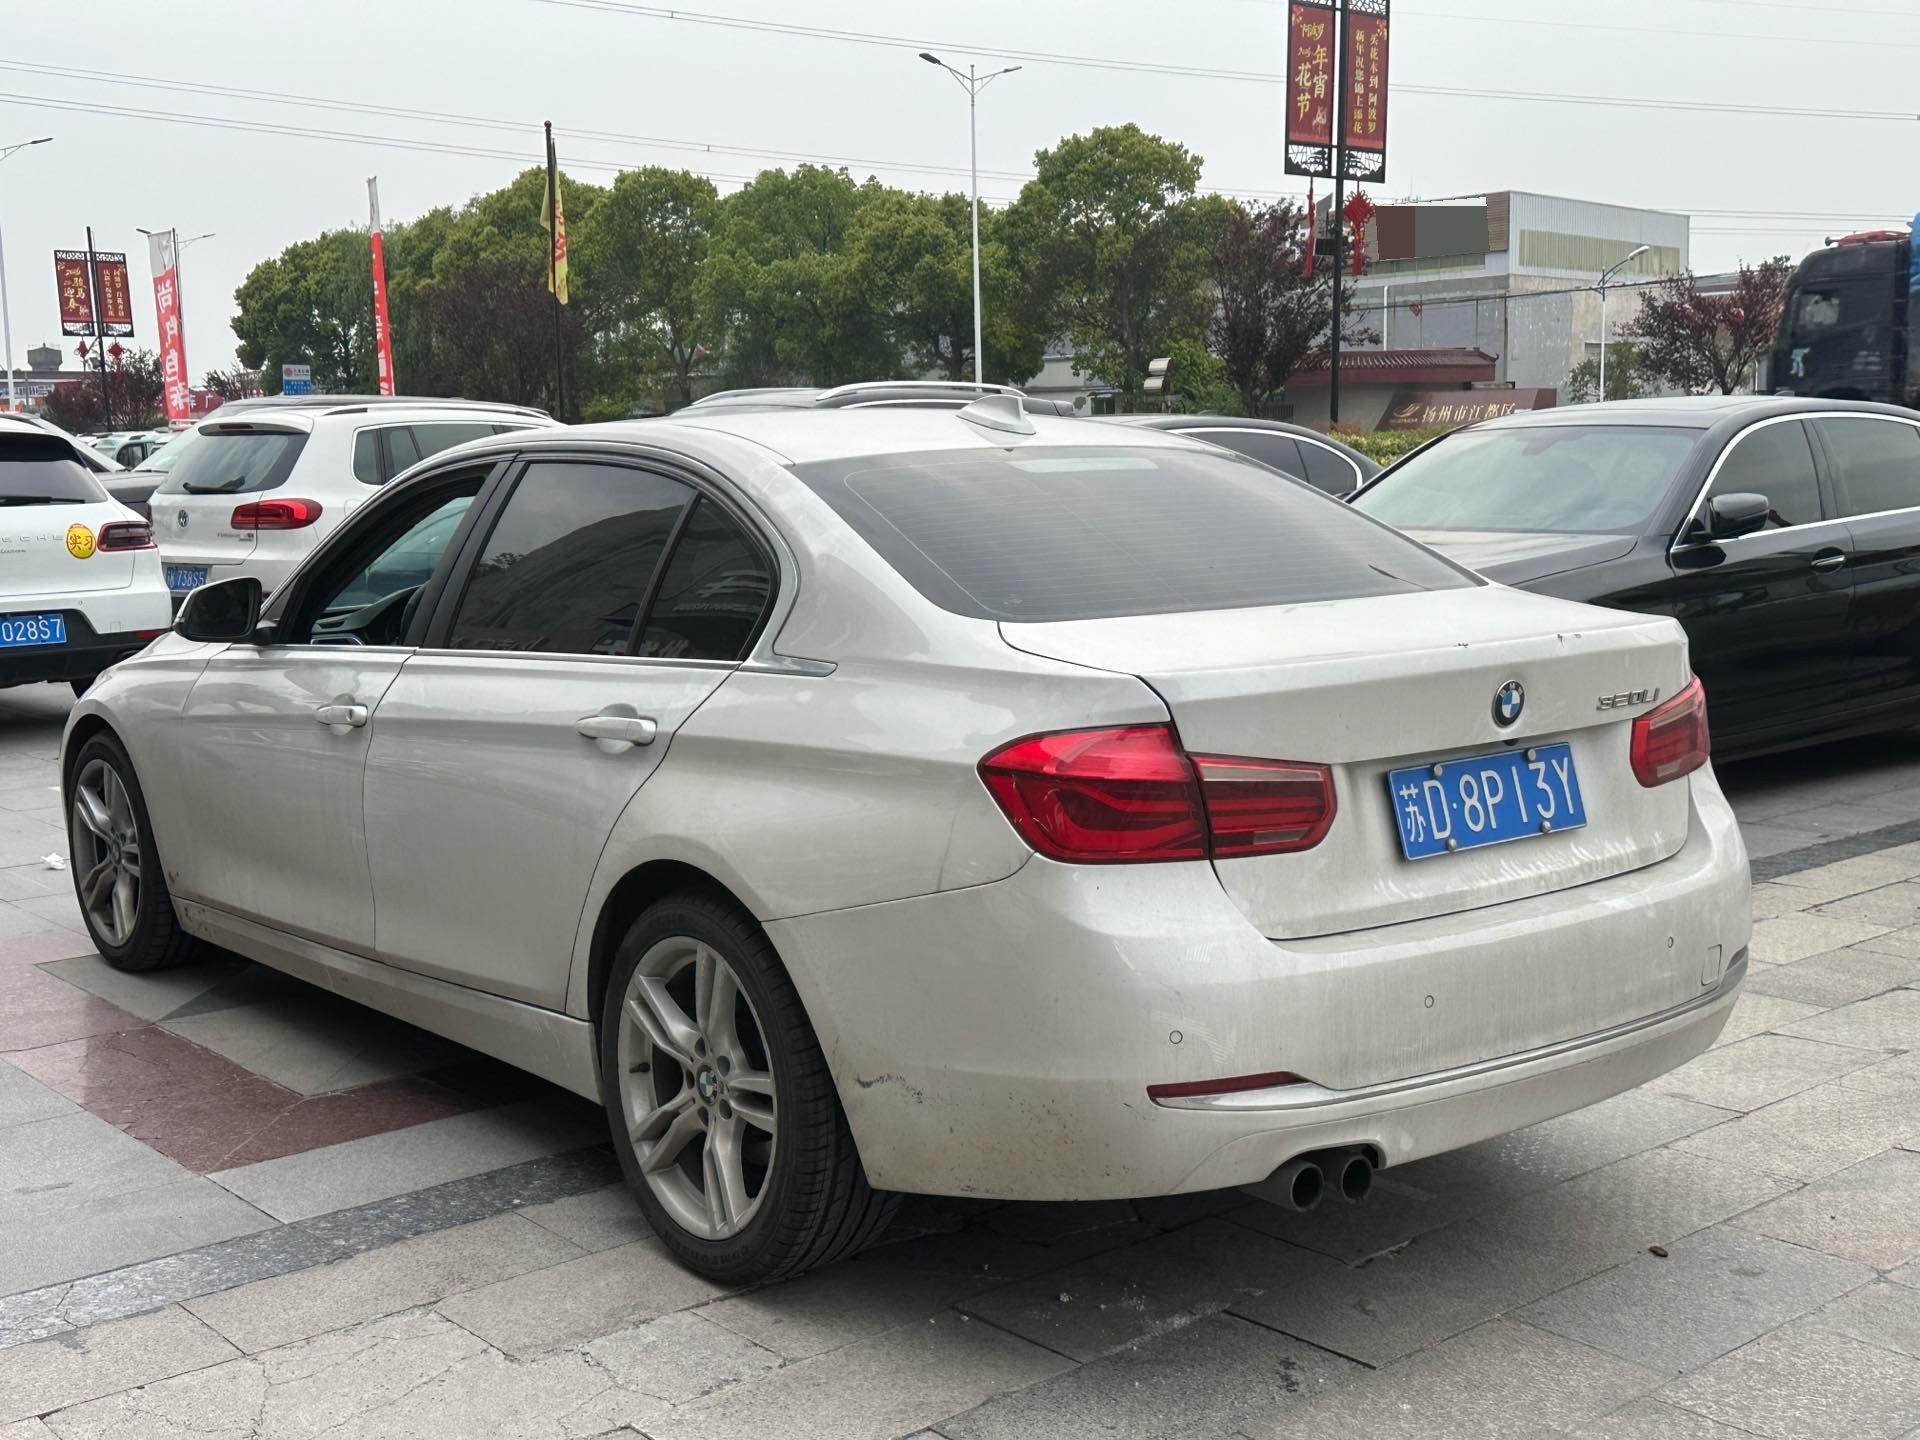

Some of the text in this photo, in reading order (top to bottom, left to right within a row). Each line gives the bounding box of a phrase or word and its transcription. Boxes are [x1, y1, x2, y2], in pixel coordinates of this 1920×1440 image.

[1421, 402, 1516, 424] 扬州市江都区
[69, 533, 94, 552] 实习
[1399, 756, 1575, 843] 苏D·8P13Y
